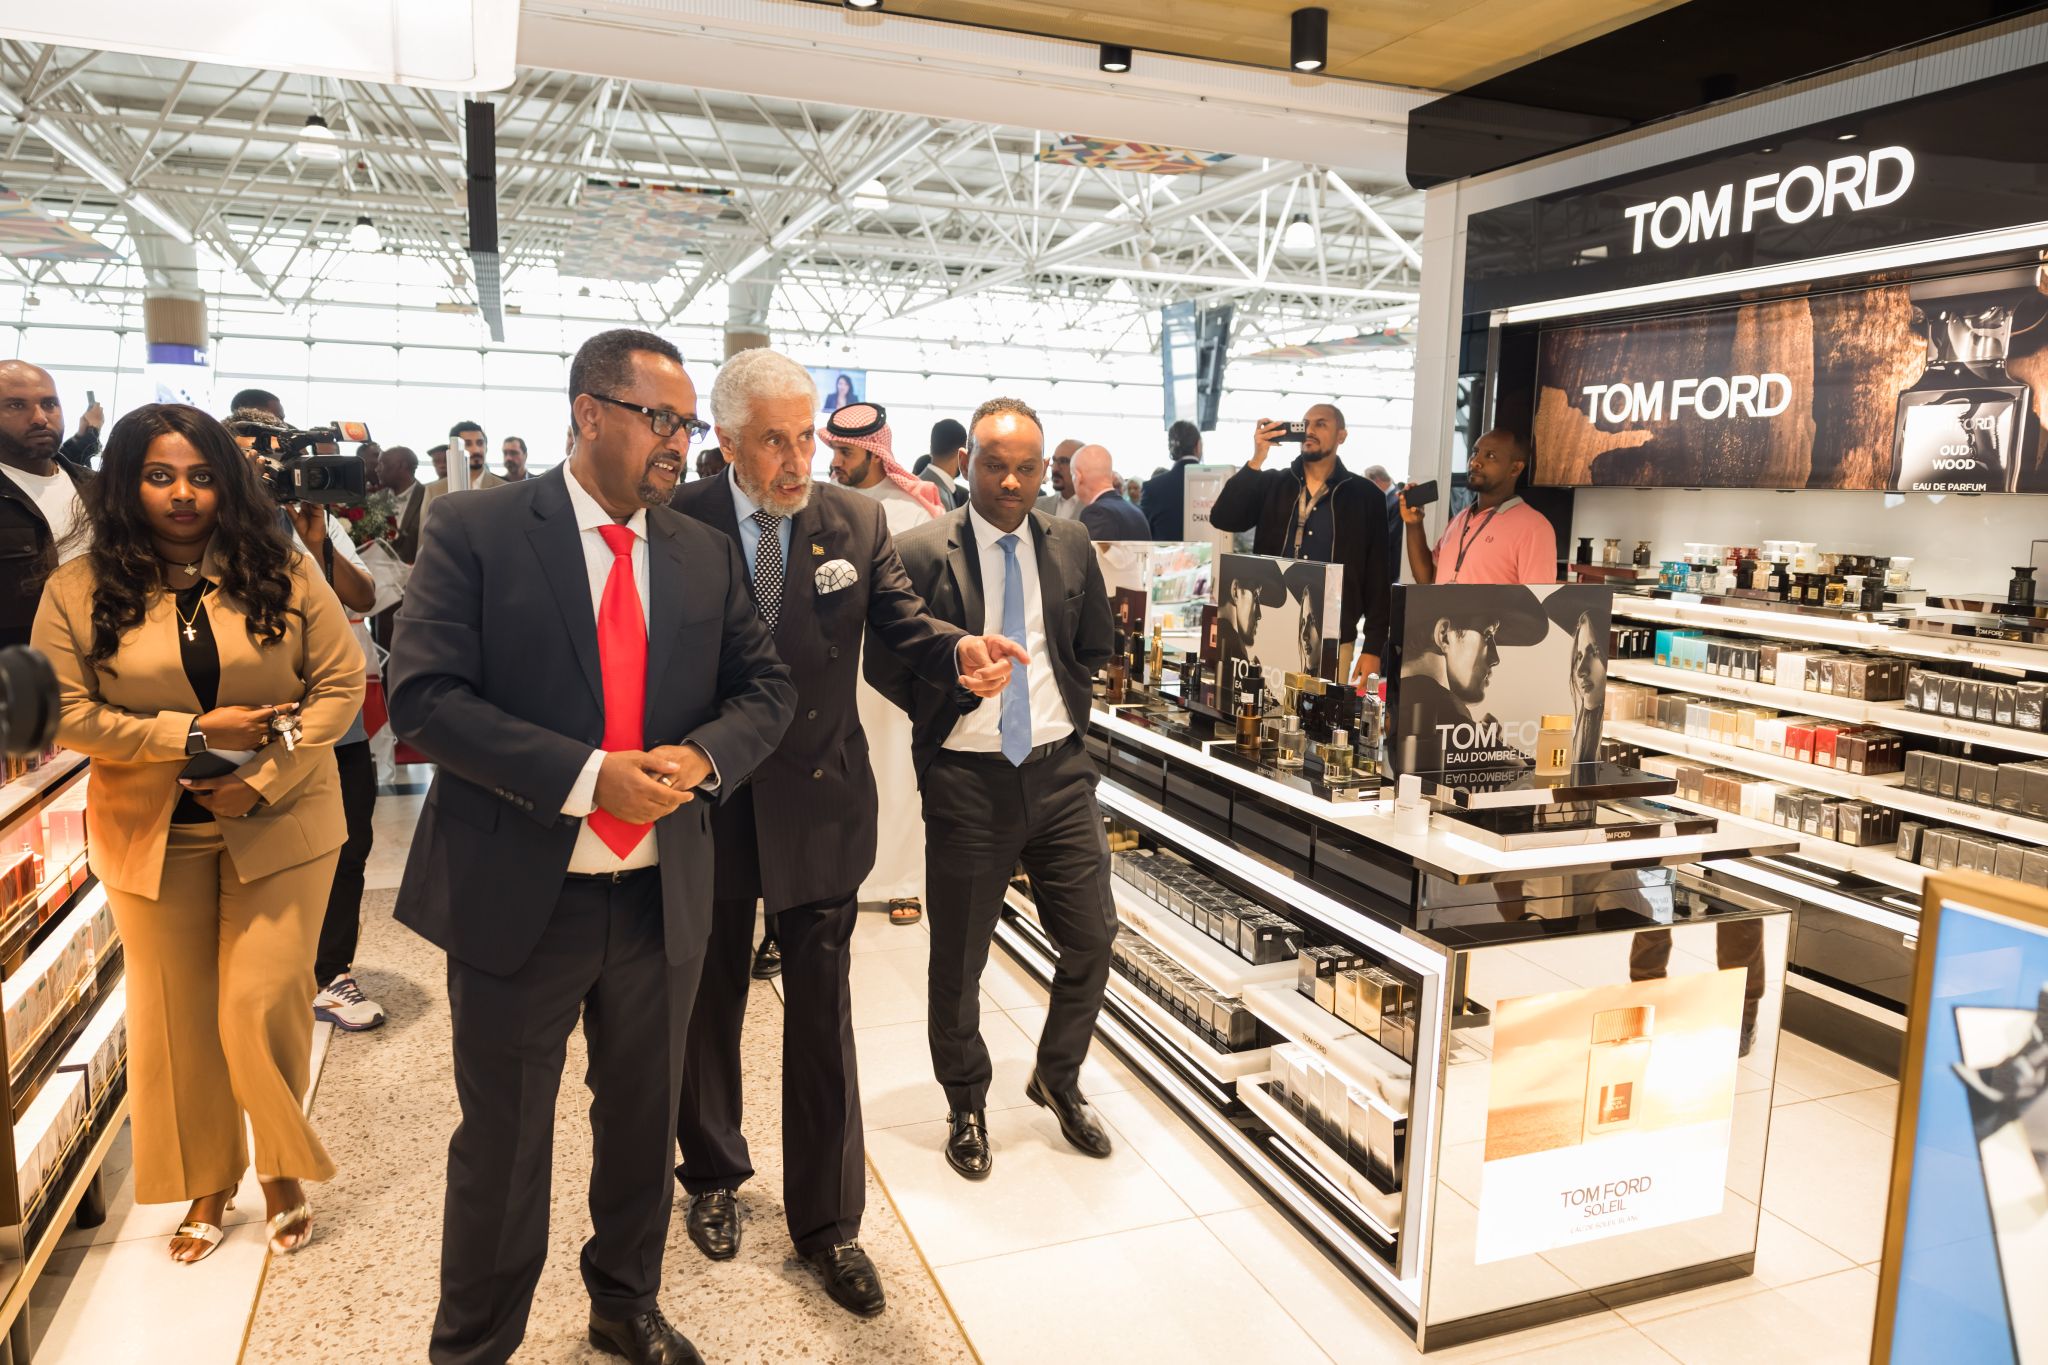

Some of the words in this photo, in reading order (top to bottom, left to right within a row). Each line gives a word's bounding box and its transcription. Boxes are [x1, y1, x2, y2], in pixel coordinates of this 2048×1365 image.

[1624, 183, 1733, 255] TOM
[1741, 145, 1915, 233] FORD
[1583, 380, 1664, 424] TOM
[1670, 373, 1793, 420] FORD
[1940, 445, 1969, 456] OUD
[1932, 458, 1976, 470] WOOD
[1913, 482, 1932, 491] EAU
[1933, 482, 1946, 491] DE
[1947, 483, 1987, 491] PARFUM
[1988, 629, 2004, 637] FORD
[1231, 656, 1250, 679] TO
[1234, 680, 1243, 690] EA
[1436, 722, 1497, 751] TOM
[1503, 720, 1540, 747] FO
[1446, 752, 1469, 764] EAU
[1614, 831, 1631, 839] FORD
[1561, 1186, 1600, 1208] TOM
[1603, 1176, 1652, 1199] FORD
[1584, 1199, 1627, 1218] SOLEIL
